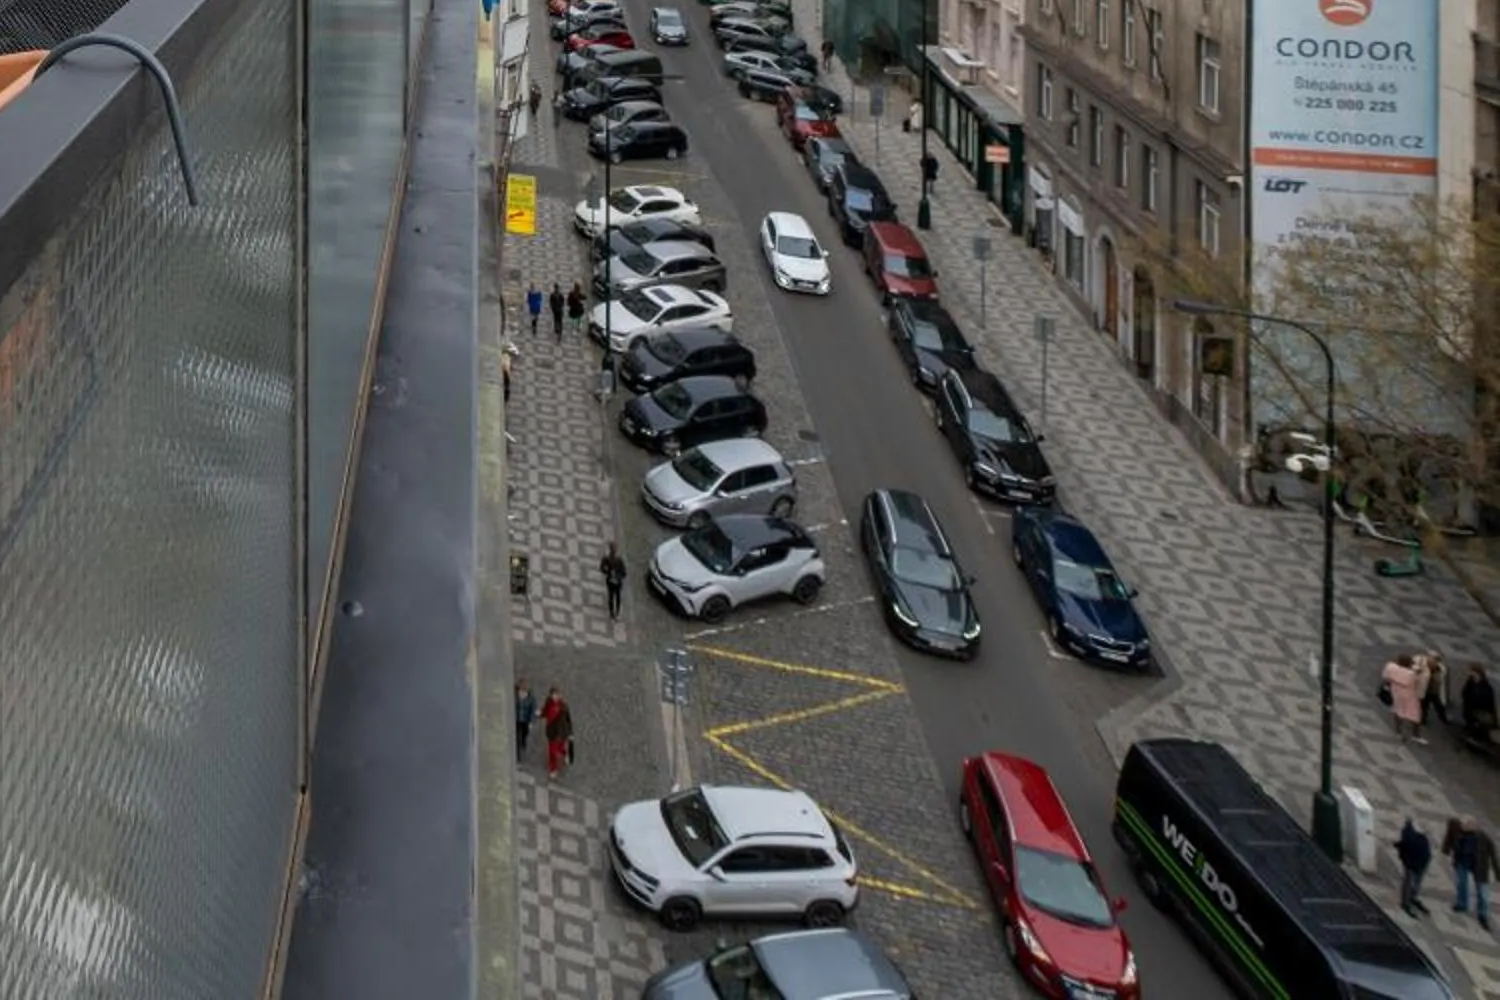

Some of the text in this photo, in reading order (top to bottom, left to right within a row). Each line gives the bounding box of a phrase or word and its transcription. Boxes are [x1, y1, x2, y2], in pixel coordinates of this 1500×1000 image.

[1276, 37, 1415, 63] CONDOR
[1377, 81, 1398, 95] 45
[1305, 97, 1333, 109] 225
[1369, 101, 1397, 113] 225
[1264, 179, 1308, 194] LOT
